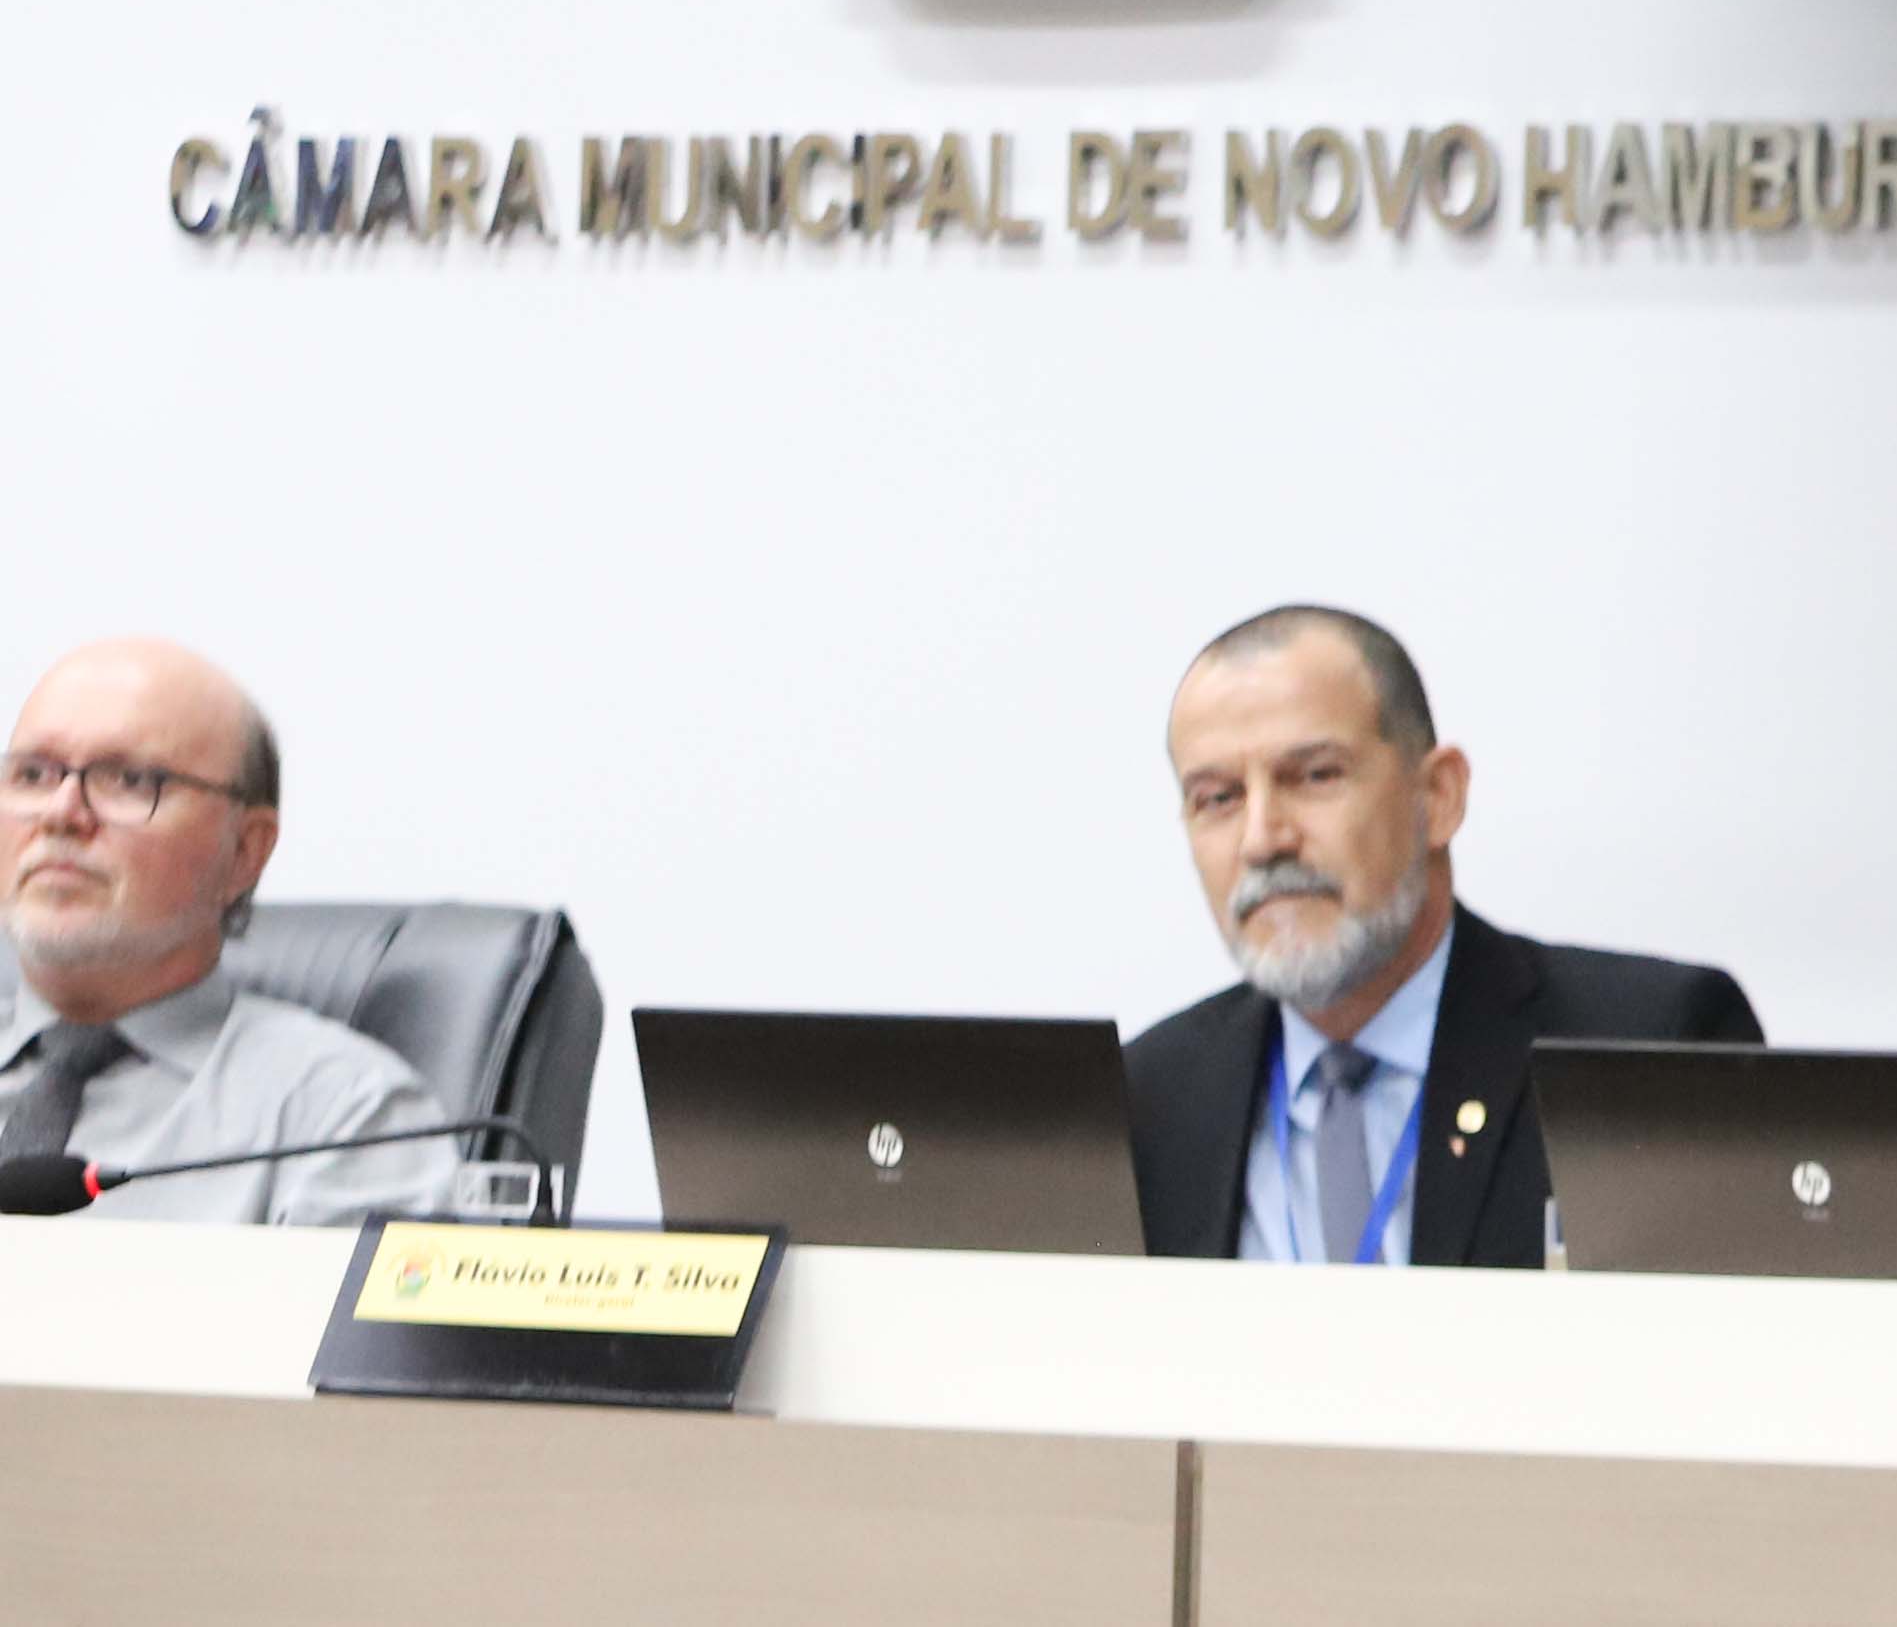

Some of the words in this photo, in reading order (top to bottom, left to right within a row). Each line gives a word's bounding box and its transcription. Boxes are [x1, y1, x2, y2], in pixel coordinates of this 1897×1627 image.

[168, 105, 559, 240] CÂMARA
[579, 130, 1042, 242] MUNICIPAL
[1067, 126, 1191, 242] DE
[1223, 121, 1498, 241] NOVO
[664, 1263, 742, 1292] Silva
